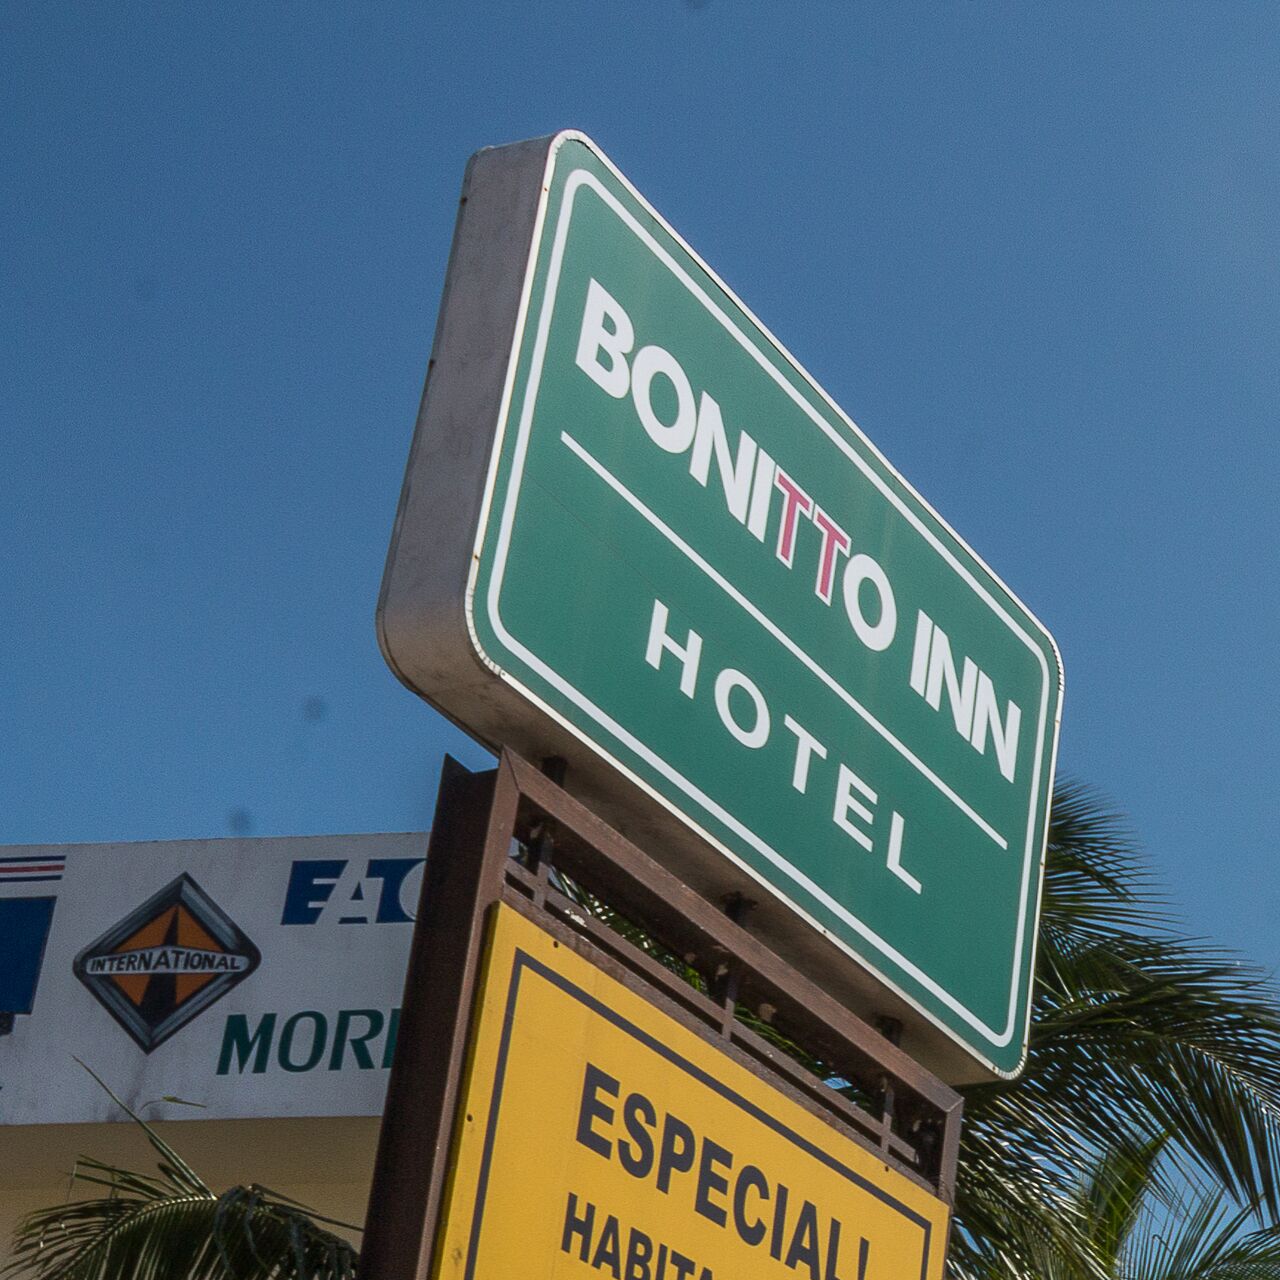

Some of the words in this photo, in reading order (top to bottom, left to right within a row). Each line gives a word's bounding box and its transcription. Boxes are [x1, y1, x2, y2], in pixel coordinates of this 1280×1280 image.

[575, 277, 898, 652] BONITTO
[910, 608, 1022, 784] INN
[645, 598, 922, 895] HOTEL
[90, 950, 241, 972] INTERNATIONAL
[216, 1008, 401, 1075] MOR
